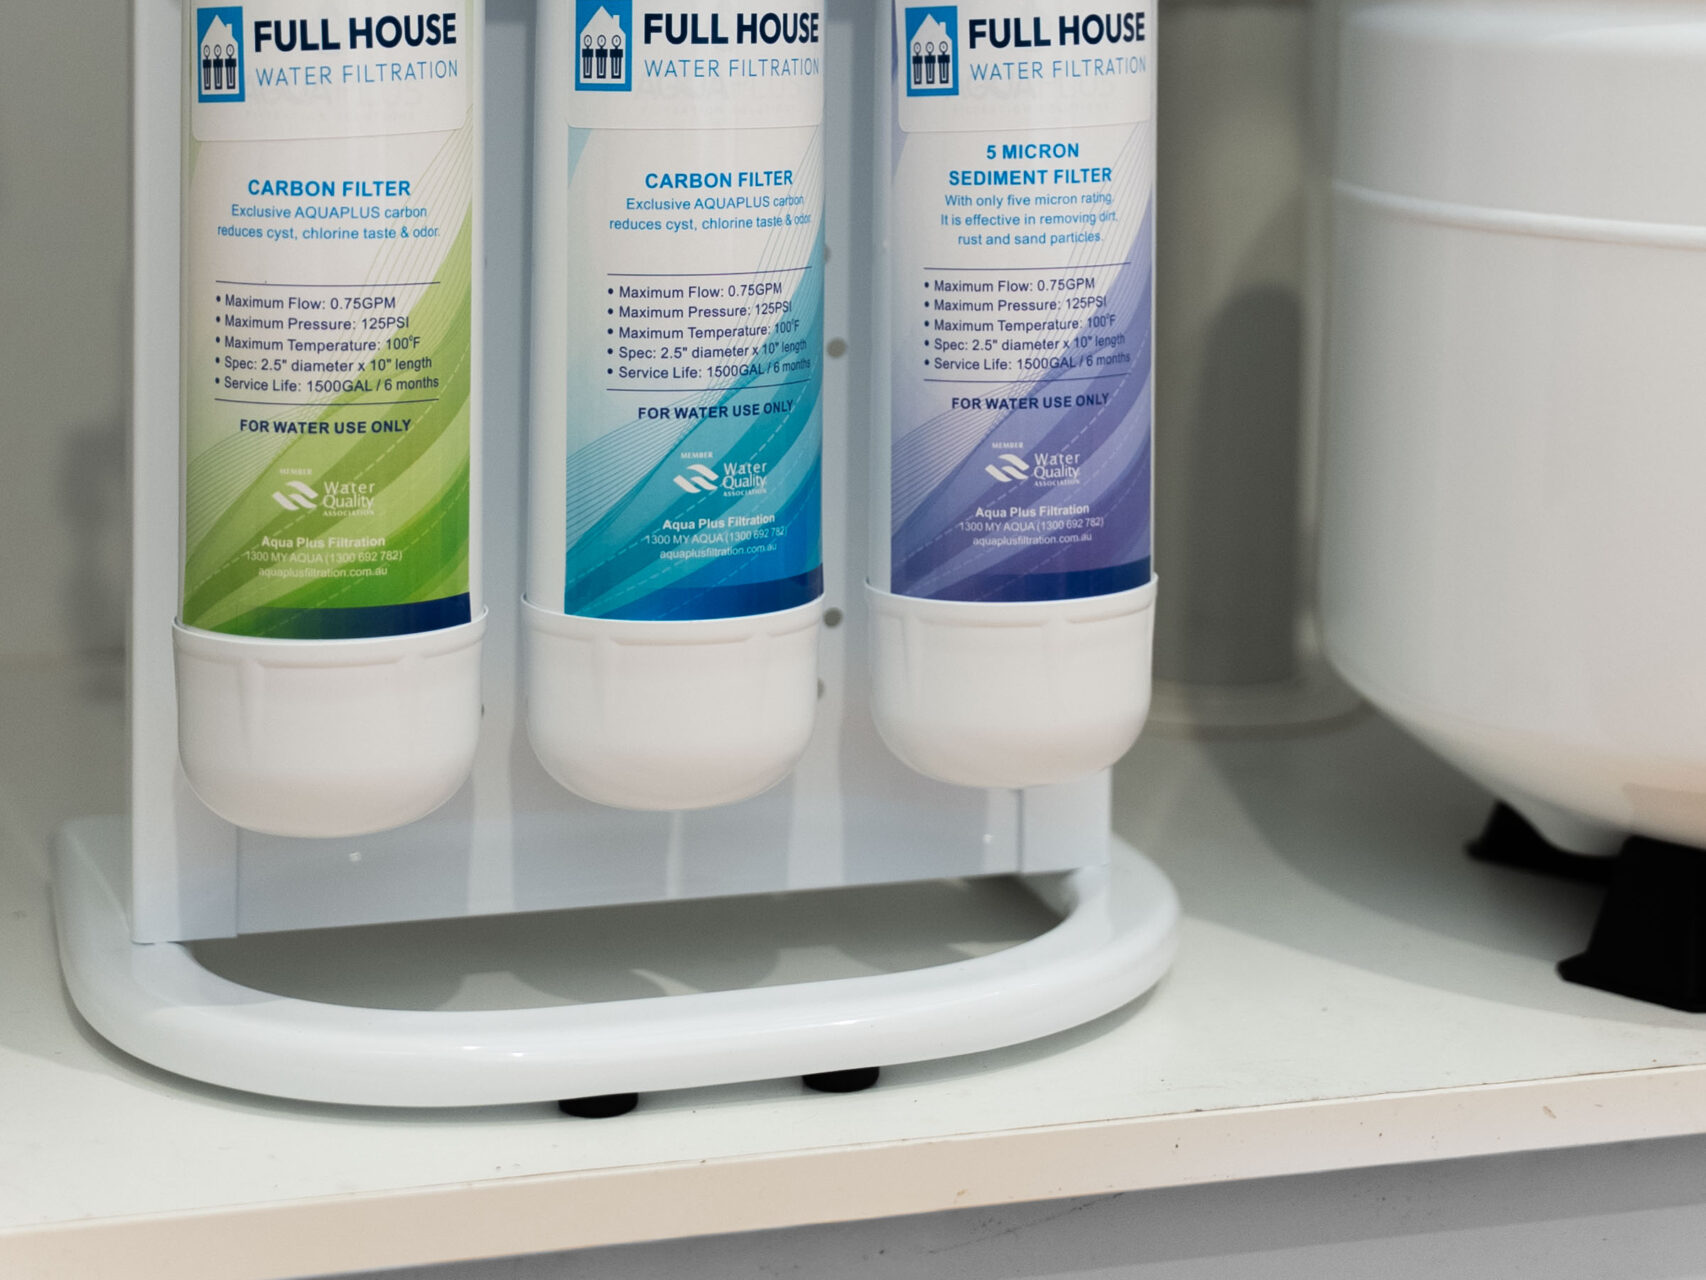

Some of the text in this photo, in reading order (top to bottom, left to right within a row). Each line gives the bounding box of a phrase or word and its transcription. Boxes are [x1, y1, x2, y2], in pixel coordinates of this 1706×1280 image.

[254, 13, 457, 53] FULL HOUSE
[644, 12, 819, 44] FULL HOUSE
[969, 11, 1146, 49] FULL HOUSE
[256, 59, 458, 87] WATER FILTRATION
[644, 58, 819, 77] WATER FILTRATION
[970, 56, 1146, 81] WATER FILTRATION
[987, 143, 1079, 159] 5 MICRON
[645, 170, 793, 189] CARBON FILTER
[949, 168, 1112, 185] SEDIMENT FILTER
[248, 180, 411, 197] CARBON FILTER
[945, 194, 972, 206] With
[976, 195, 1003, 209] only
[1007, 194, 1030, 206] five
[1035, 194, 1077, 205] micron
[232, 204, 427, 219] Exclusive AQUAPLUS carbon
[941, 214, 948, 225] It
[952, 214, 962, 225] is
[965, 214, 1020, 226] effective
[1025, 214, 1035, 225] in
[1040, 213, 1096, 226] removing
[217, 226, 263, 238] reduces
[303, 228, 359, 239] chlorine
[363, 227, 396, 239] taste
[400, 226, 409, 238] &
[958, 235, 982, 245] rust
[986, 233, 1010, 245] and
[1015, 233, 1046, 245] sand
[619, 282, 782, 299] Maximum Flow: 0.75GPM
[934, 278, 1095, 292] Maximum Flow: 0.75GPM
[225, 294, 396, 309] Maximum Flow: 0.75GPM
[619, 301, 792, 318] Maximum Pressure: 125PSI
[934, 296, 1107, 312] Maximum Pressure: 125PSI
[225, 315, 409, 330] Maximum Pressure: 125PSI
[934, 319, 993, 332] Maximum
[998, 318, 1082, 333] Temperature:
[225, 336, 283, 351] Maximum
[288, 339, 381, 353] Temperature:
[934, 339, 968, 352] Spec:
[1002, 338, 1060, 351] diameter
[1063, 340, 1069, 349] x
[1095, 333, 1125, 348] length
[225, 356, 258, 372] Spec:
[291, 360, 354, 371] diameter
[358, 362, 365, 371] x
[395, 356, 432, 372] length
[934, 352, 1130, 370] Service Life: 1500GAL / 6 months
[224, 376, 439, 392] Service Life: 1500GAL / 6 months
[952, 392, 1110, 410] FOR WATER USE ONLY
[638, 399, 794, 420] FOR WATER USE ONLY
[240, 419, 411, 434] FOR WATER USE ONLY
[1035, 453, 1080, 465] Water
[724, 462, 767, 475] Water
[1034, 466, 1080, 479] Quality
[324, 481, 375, 494] Water
[722, 475, 766, 488] Quality
[323, 494, 375, 509] Quality
[975, 504, 1090, 519] Aqua Plus Filtration
[261, 536, 385, 549] Aqua Plus Filtration
